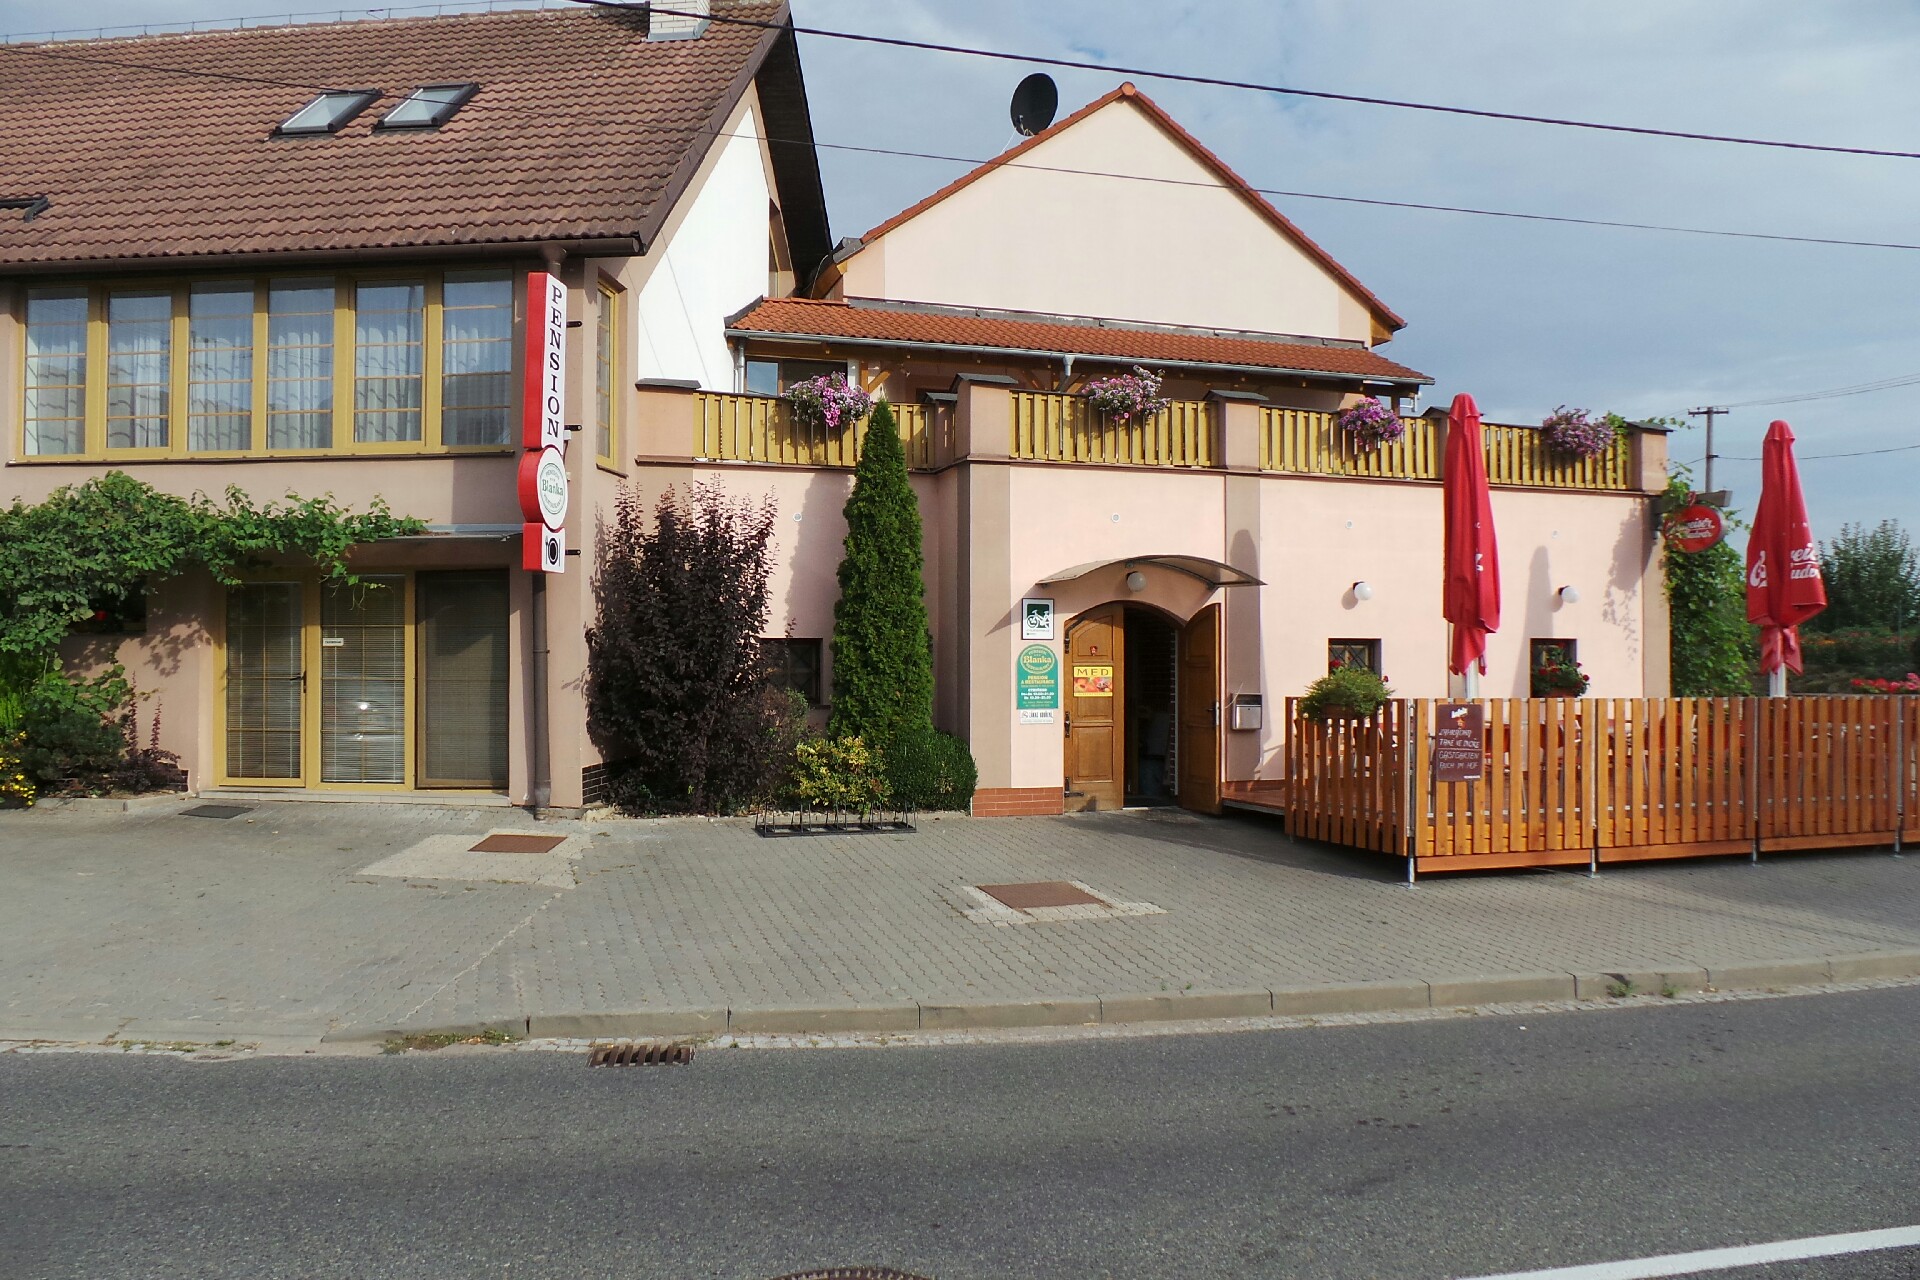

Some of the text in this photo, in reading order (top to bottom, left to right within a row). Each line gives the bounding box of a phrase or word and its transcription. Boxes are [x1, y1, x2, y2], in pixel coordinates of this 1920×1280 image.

[547, 284, 563, 438] PENSION
[542, 479, 563, 496] Blanka
[1023, 655, 1052, 664] Blanka
